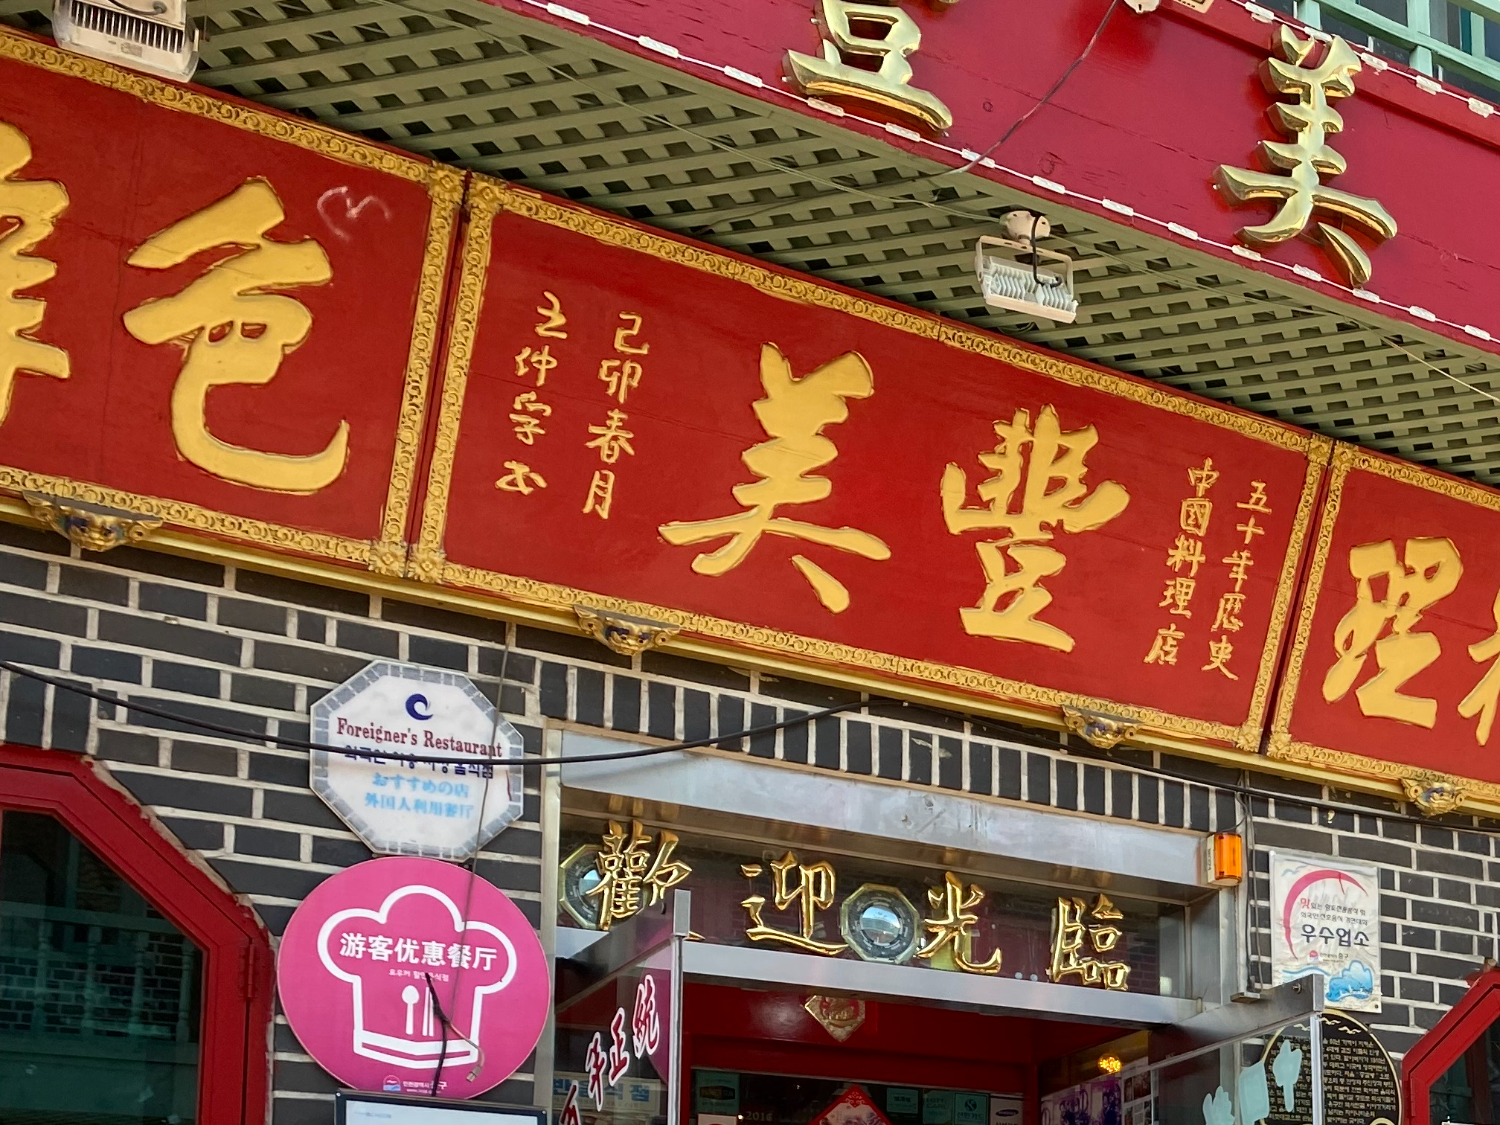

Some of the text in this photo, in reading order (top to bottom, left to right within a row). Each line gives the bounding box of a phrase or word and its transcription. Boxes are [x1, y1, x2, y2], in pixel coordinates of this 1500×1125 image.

[1144, 457, 1219, 666] 中國料理店
[336, 717, 502, 758] Foreigner's Restaurant
[372, 772, 471, 798] おすすめの店
[340, 932, 498, 971] 游客优惠餐厅
[1301, 924, 1369, 947] 우수업소
